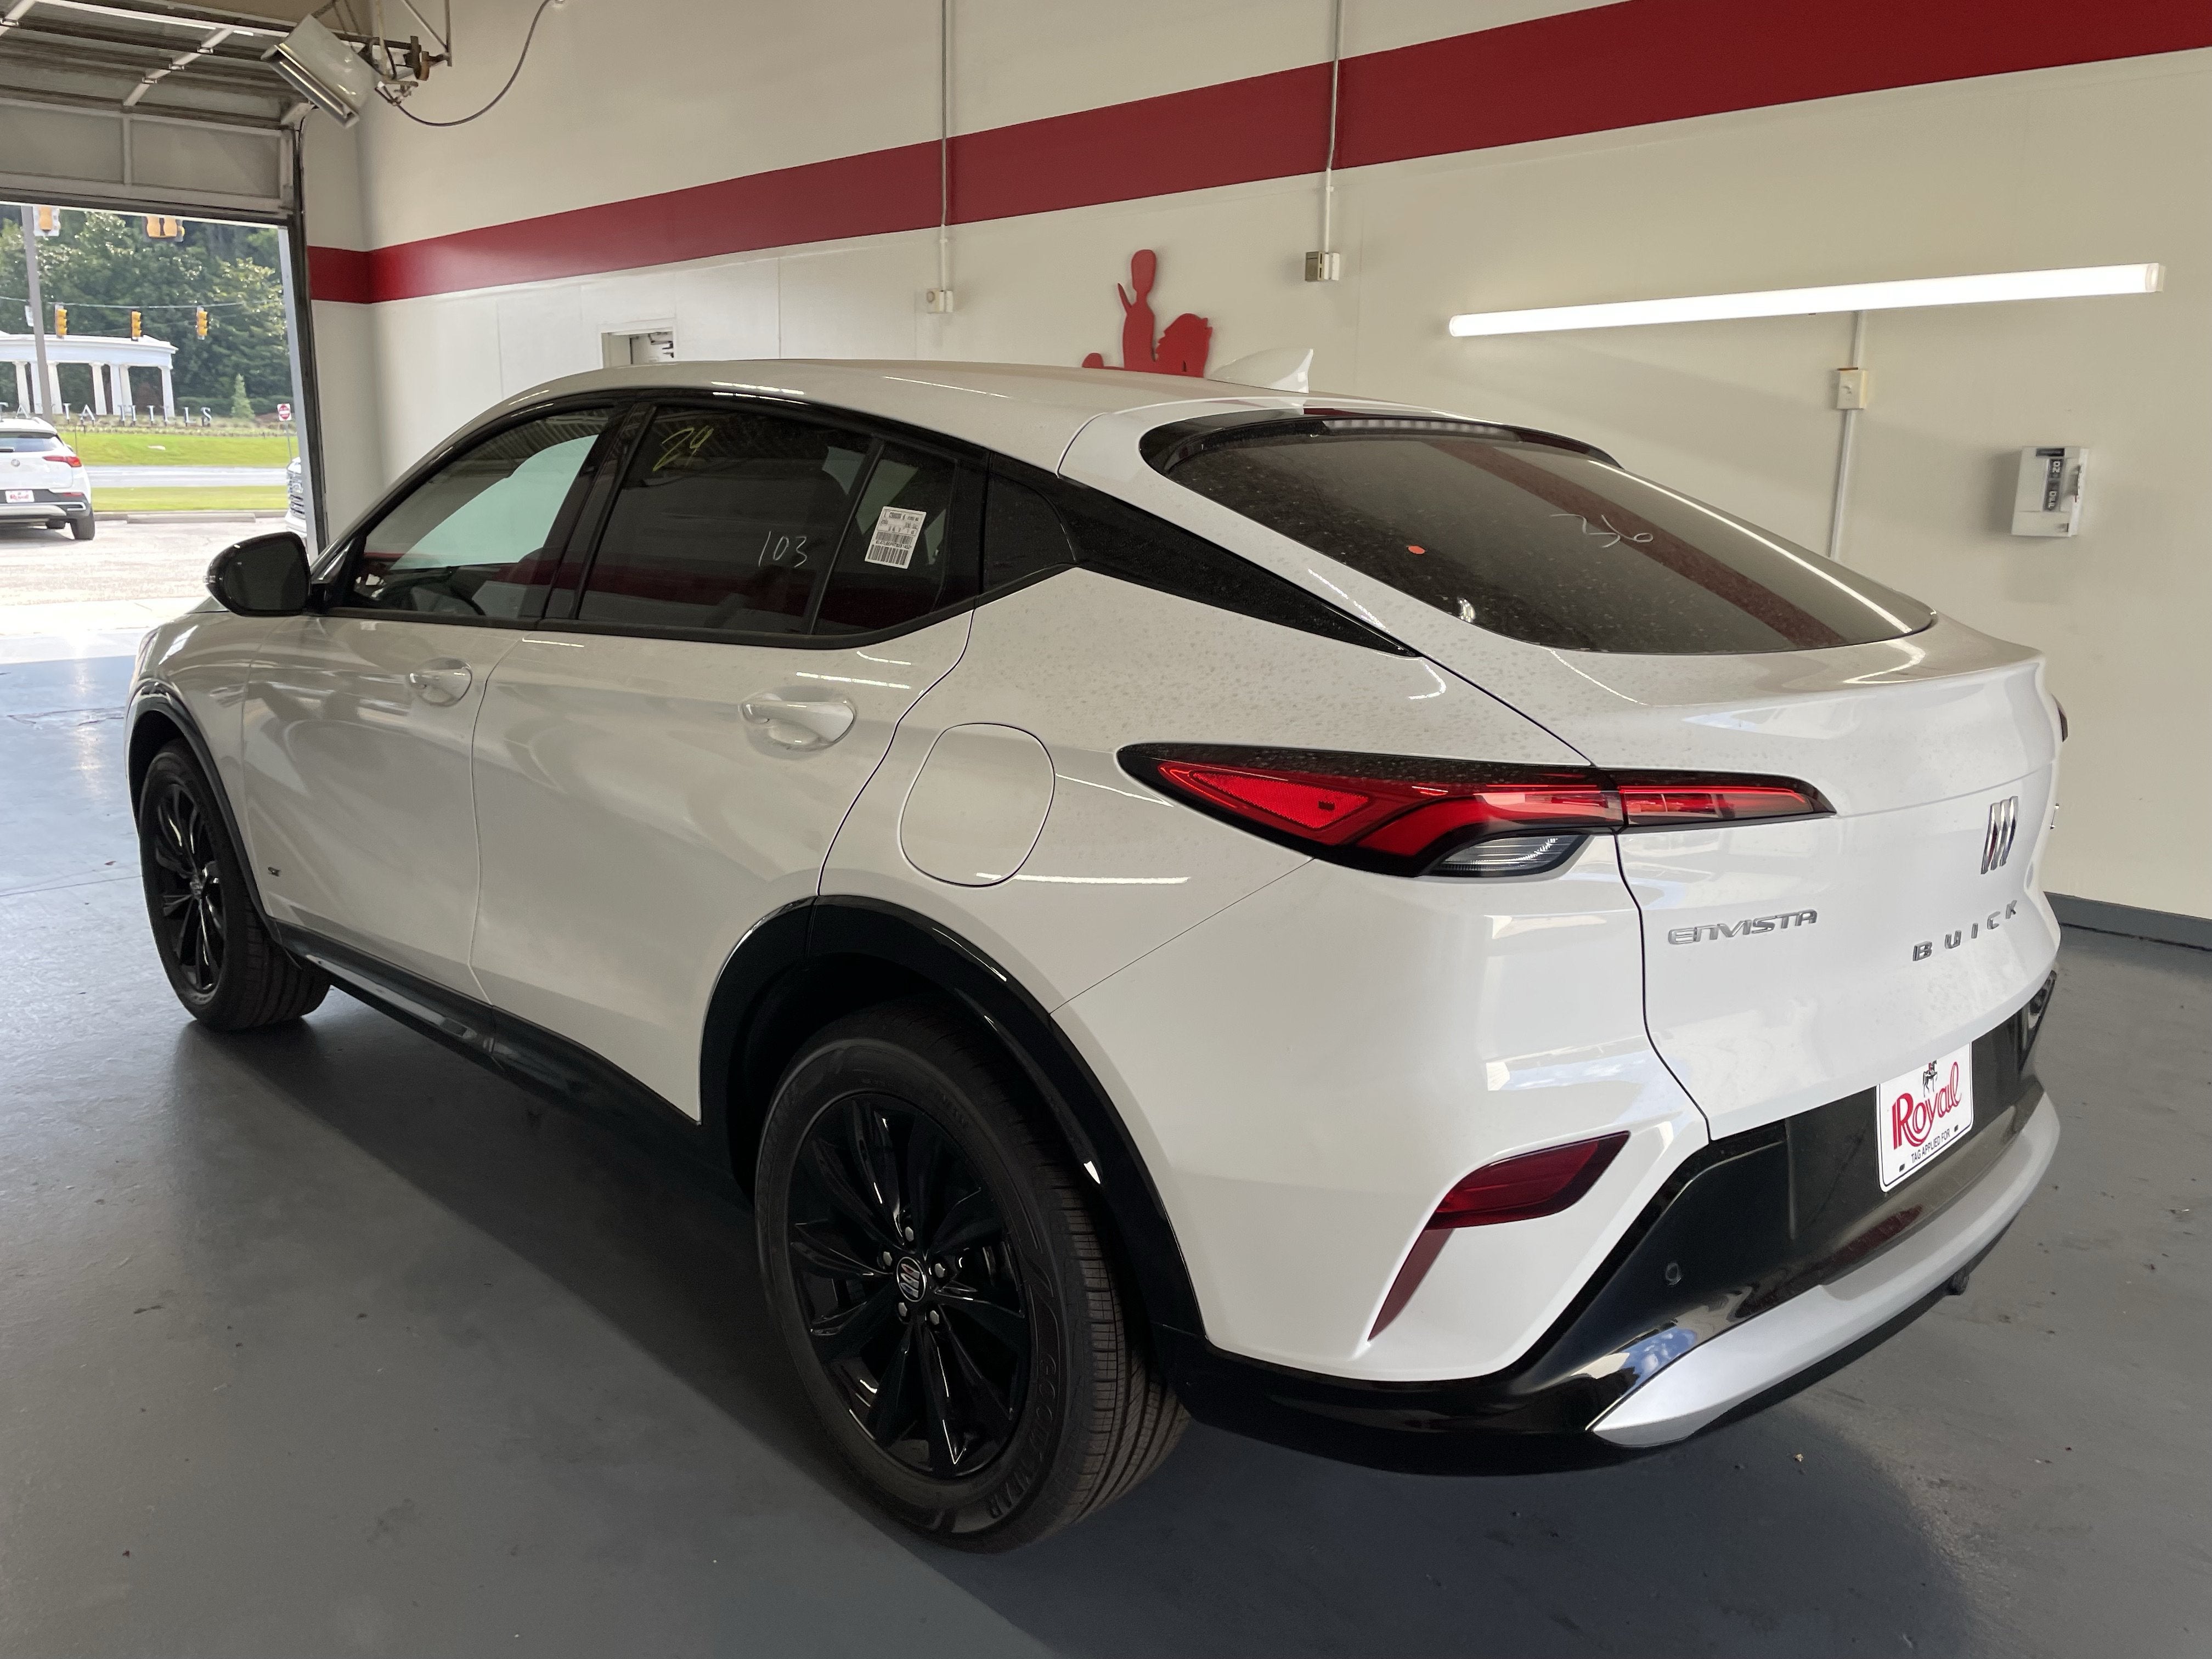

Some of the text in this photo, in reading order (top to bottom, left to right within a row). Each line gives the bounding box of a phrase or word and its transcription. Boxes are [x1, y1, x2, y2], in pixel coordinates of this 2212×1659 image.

[117, 404, 212, 424] HILLS
[759, 531, 808, 567] 103
[1668, 909, 1818, 945] ENVISTA
[1912, 900, 2018, 962] BUICK
[1892, 1062, 1962, 1150] Royal
[1911, 1128, 1950, 1163] TAG APPLIED FOR
